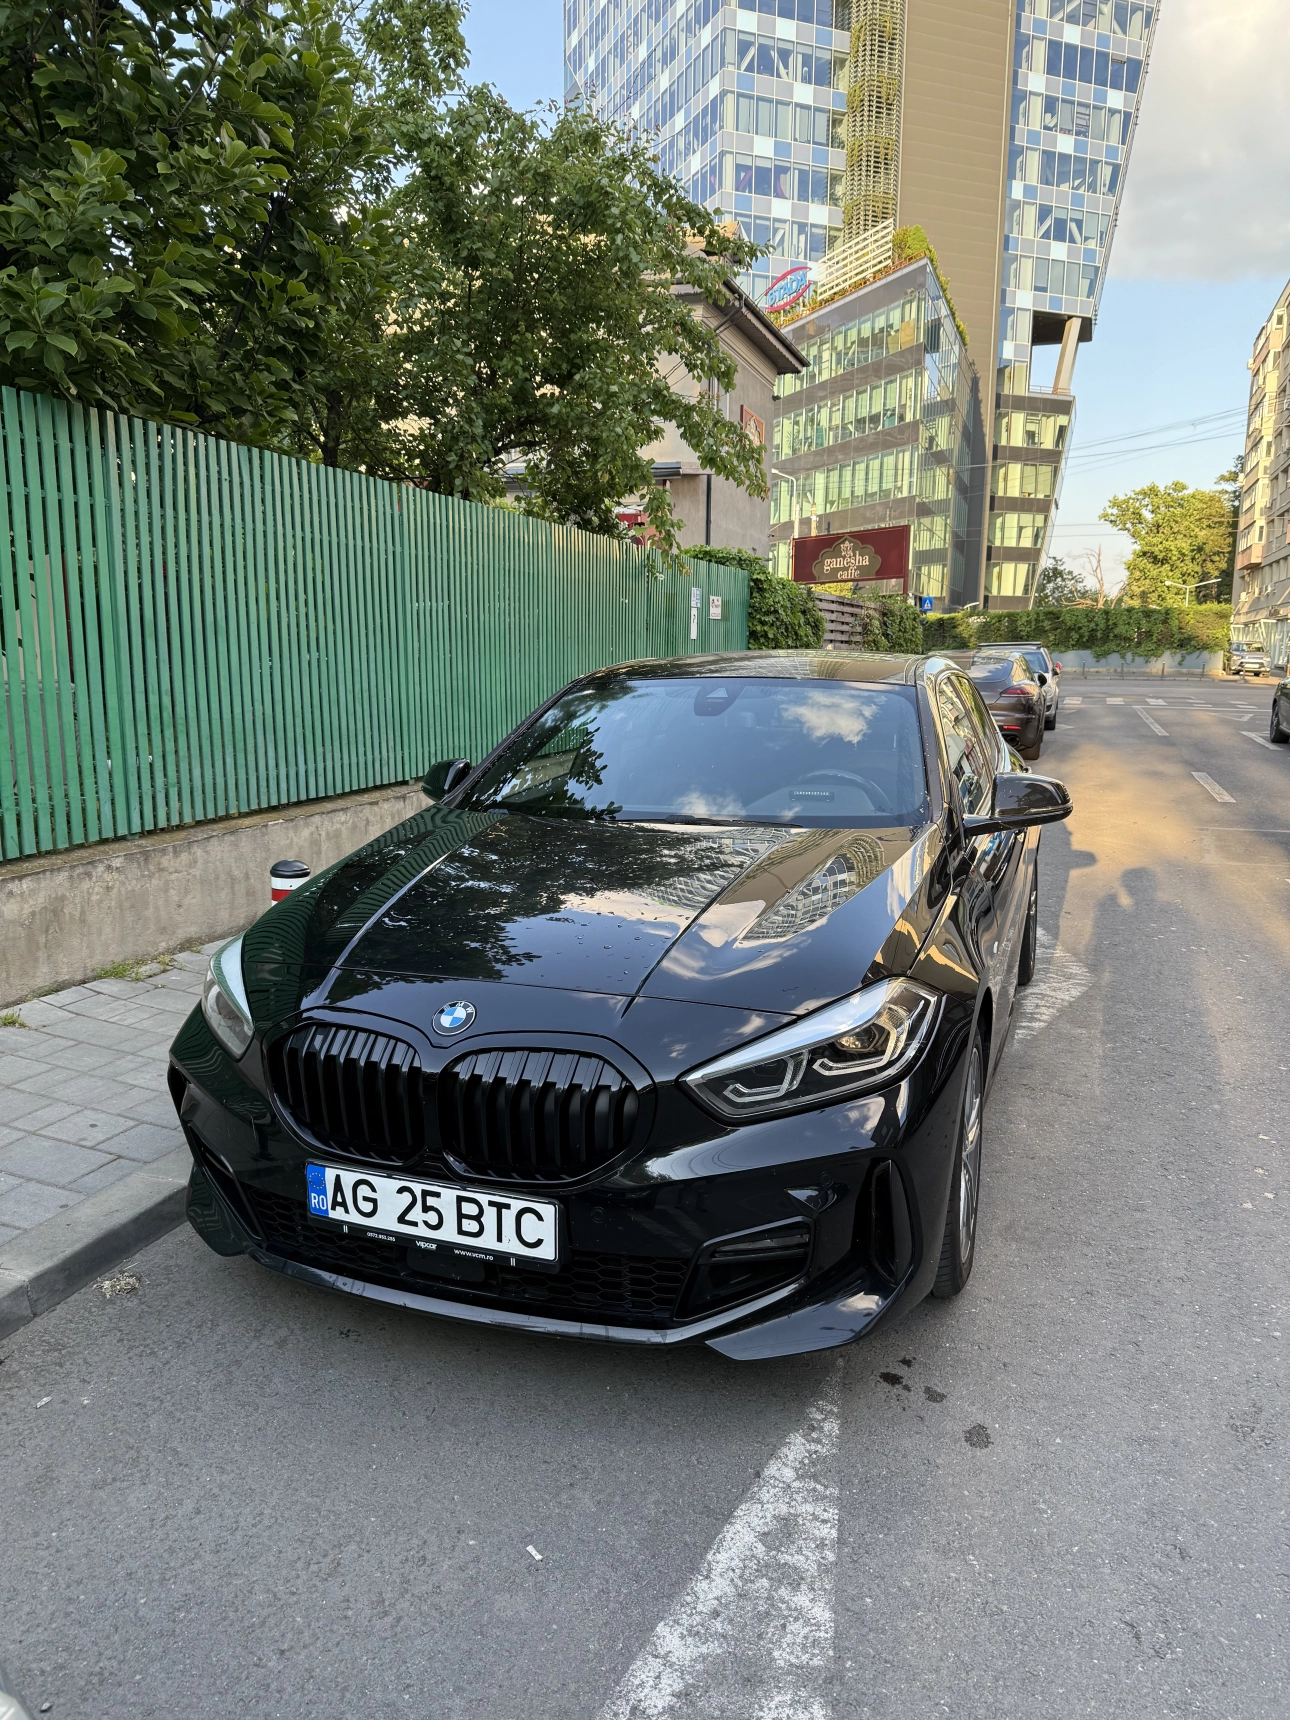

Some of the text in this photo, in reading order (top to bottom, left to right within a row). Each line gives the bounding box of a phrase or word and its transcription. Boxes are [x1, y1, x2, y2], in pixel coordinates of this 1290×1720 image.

[767, 270, 807, 306] STADA
[823, 551, 869, 573] ganesha
[311, 1192, 328, 1210] RO
[331, 1173, 545, 1249] AG 25 BTC
[453, 1248, 494, 1261] www.vcm.ro
